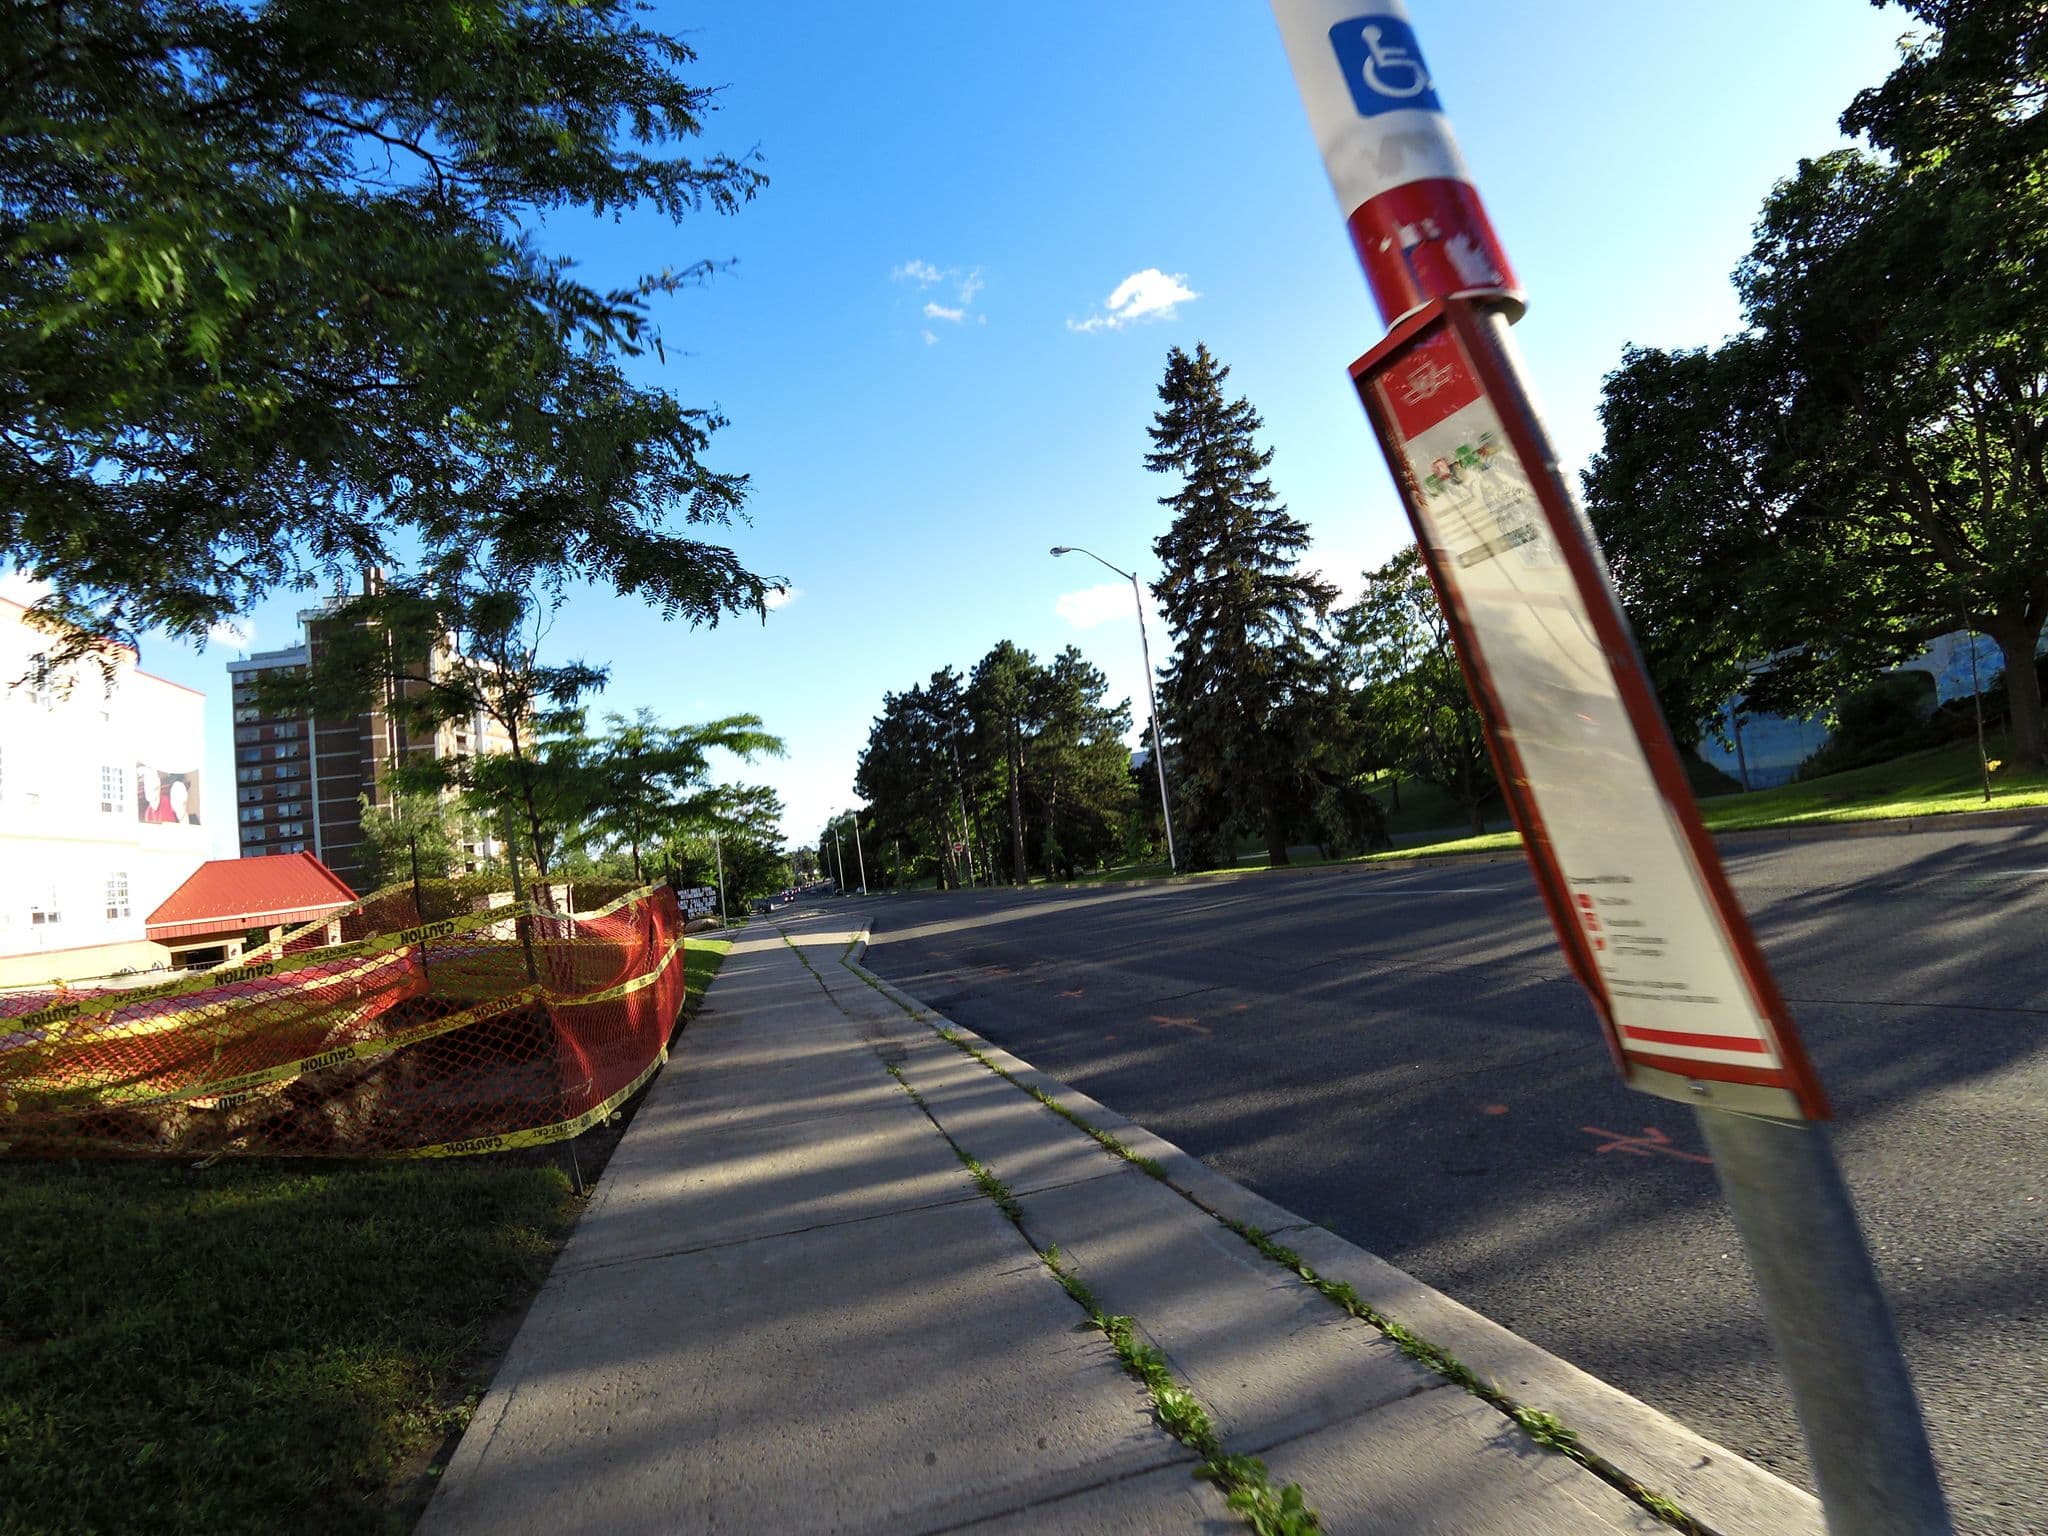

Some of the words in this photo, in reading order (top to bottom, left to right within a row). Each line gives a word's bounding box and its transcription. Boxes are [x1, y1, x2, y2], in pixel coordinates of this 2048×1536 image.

[400, 920, 454, 945] CAUTION
[214, 962, 274, 986] CAUTION
[22, 1004, 80, 1029] CAUTION
[300, 1047, 356, 1073] CAUTION
[446, 1135, 502, 1154] CAUTION
